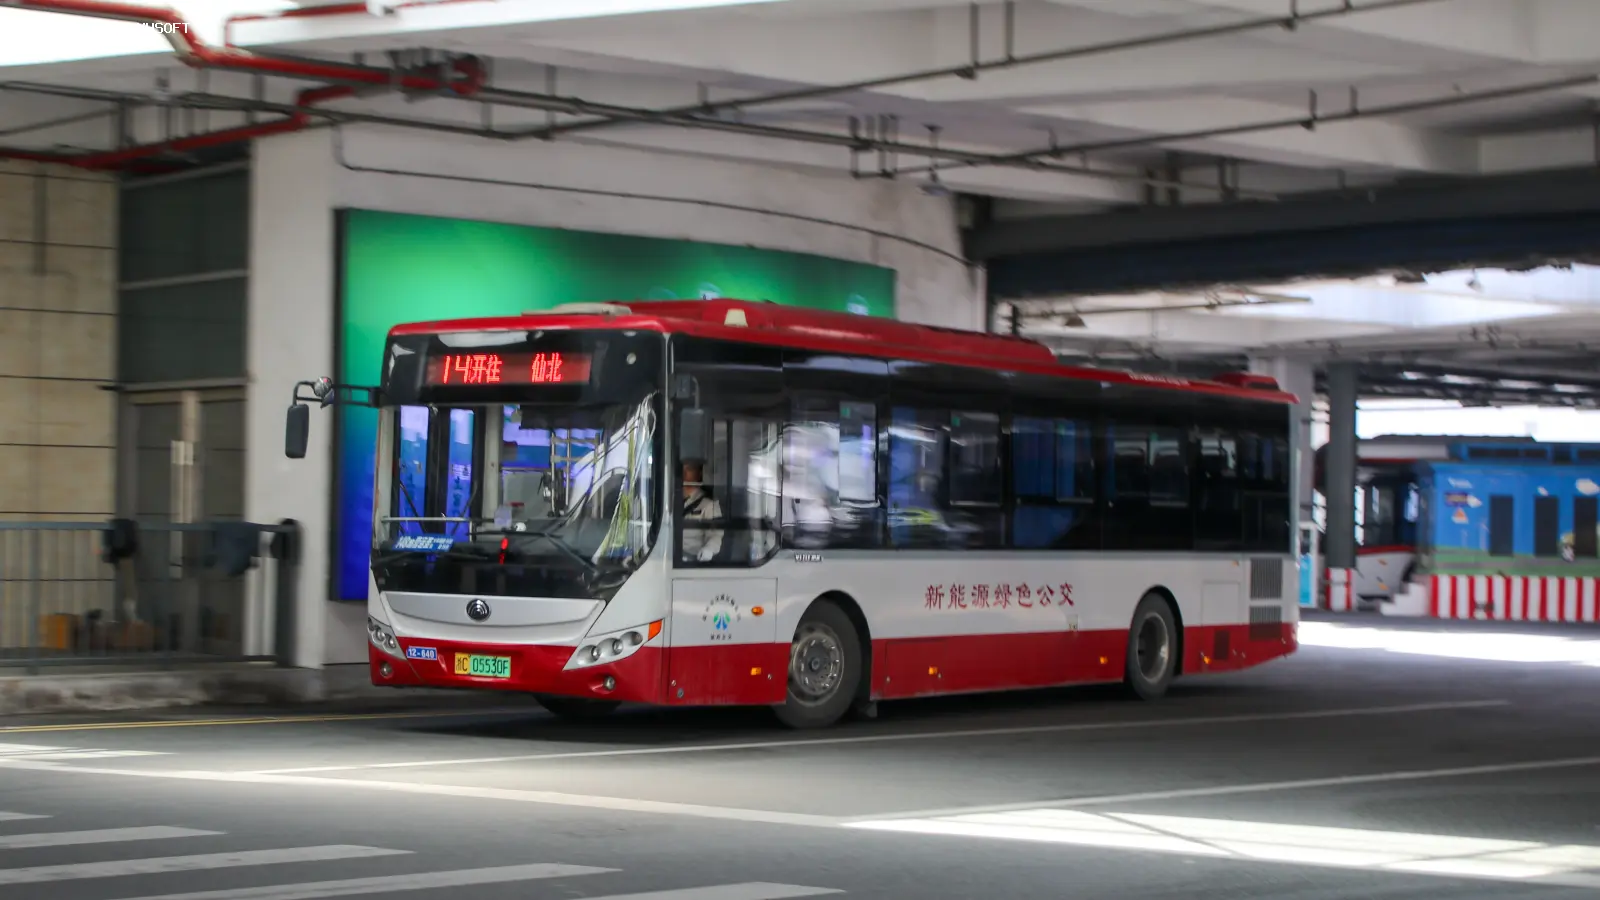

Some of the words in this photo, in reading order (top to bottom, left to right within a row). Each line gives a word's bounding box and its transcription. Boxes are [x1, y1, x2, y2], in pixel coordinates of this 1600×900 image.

[531, 352, 563, 383] 仙北
[925, 581, 1075, 610] 新能源绿色公交
[408, 648, 435, 659] 12-640
